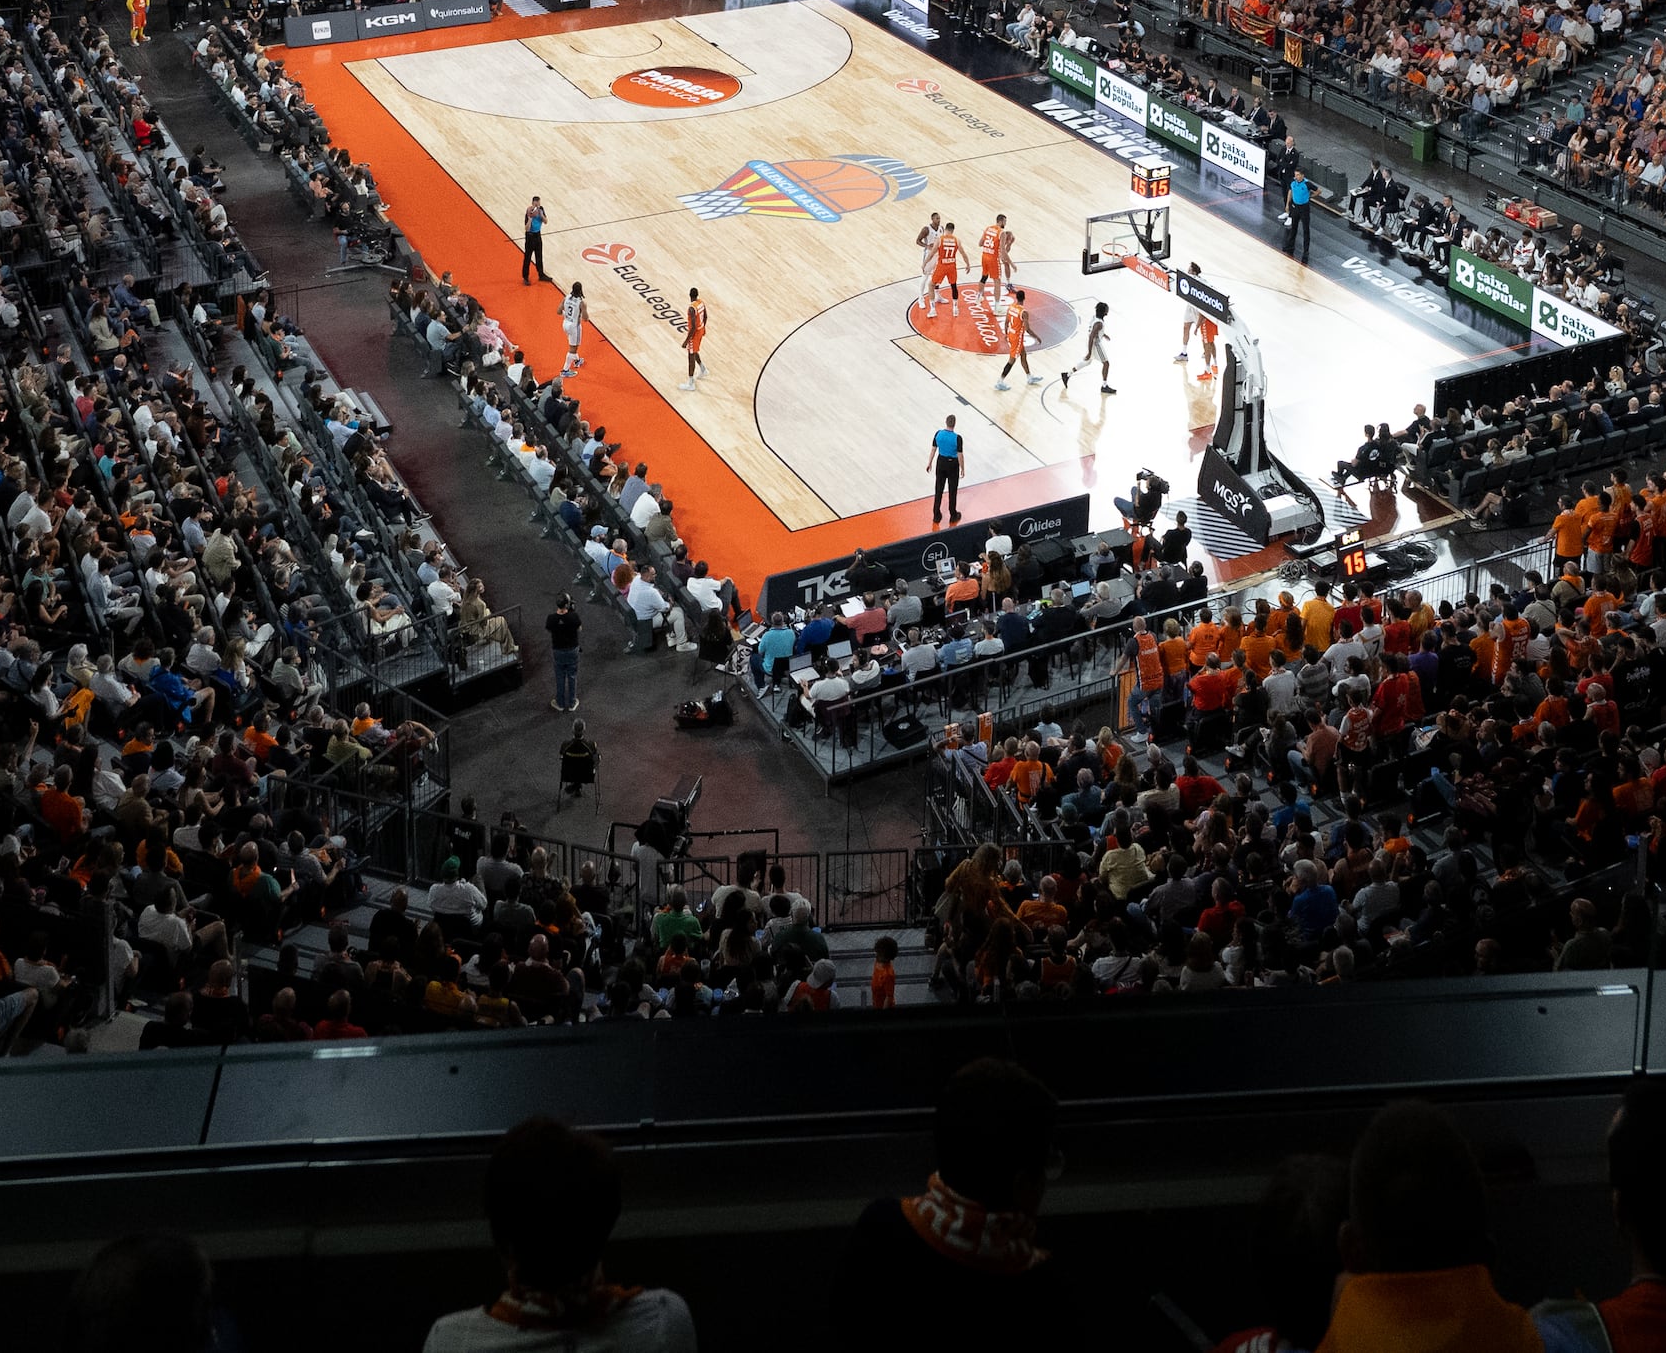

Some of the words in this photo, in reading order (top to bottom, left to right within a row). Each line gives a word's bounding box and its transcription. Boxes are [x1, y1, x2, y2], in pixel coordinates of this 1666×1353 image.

[365, 12, 416, 29] KGM
[883, 9, 941, 41] Vitaldin
[1063, 66, 1094, 88] popular
[1064, 58, 1084, 74] caixa
[639, 70, 725, 100] PAMESA
[1113, 85, 1132, 100] caixa
[925, 89, 1005, 140] EuroLeague
[1112, 93, 1143, 115] popular
[1164, 110, 1187, 127] caixa
[1084, 109, 1122, 129] ROIG
[1118, 129, 1170, 154] ARENA
[1163, 120, 1199, 144] popular
[1222, 141, 1246, 159] caixa
[1221, 151, 1259, 175] popular
[754, 162, 793, 194] VALENCIA
[792, 189, 832, 221] BASKET
[1133, 177, 1146, 196] 15
[1150, 180, 1168, 197] 15
[943, 246, 955, 257] 77
[1136, 265, 1149, 278] abu
[1148, 273, 1167, 289] dhabi
[1341, 255, 1442, 314] Vitaldin
[1477, 270, 1510, 295] caixa
[614, 264, 688, 333] EuroLeague
[1190, 286, 1223, 312] motorola
[1476, 282, 1527, 314] popular
[1562, 312, 1596, 338] caixa
[1213, 479, 1239, 508] MGS
[1019, 517, 1061, 537] Midea
[928, 550, 943, 561] SH
[1343, 550, 1365, 576] 15
